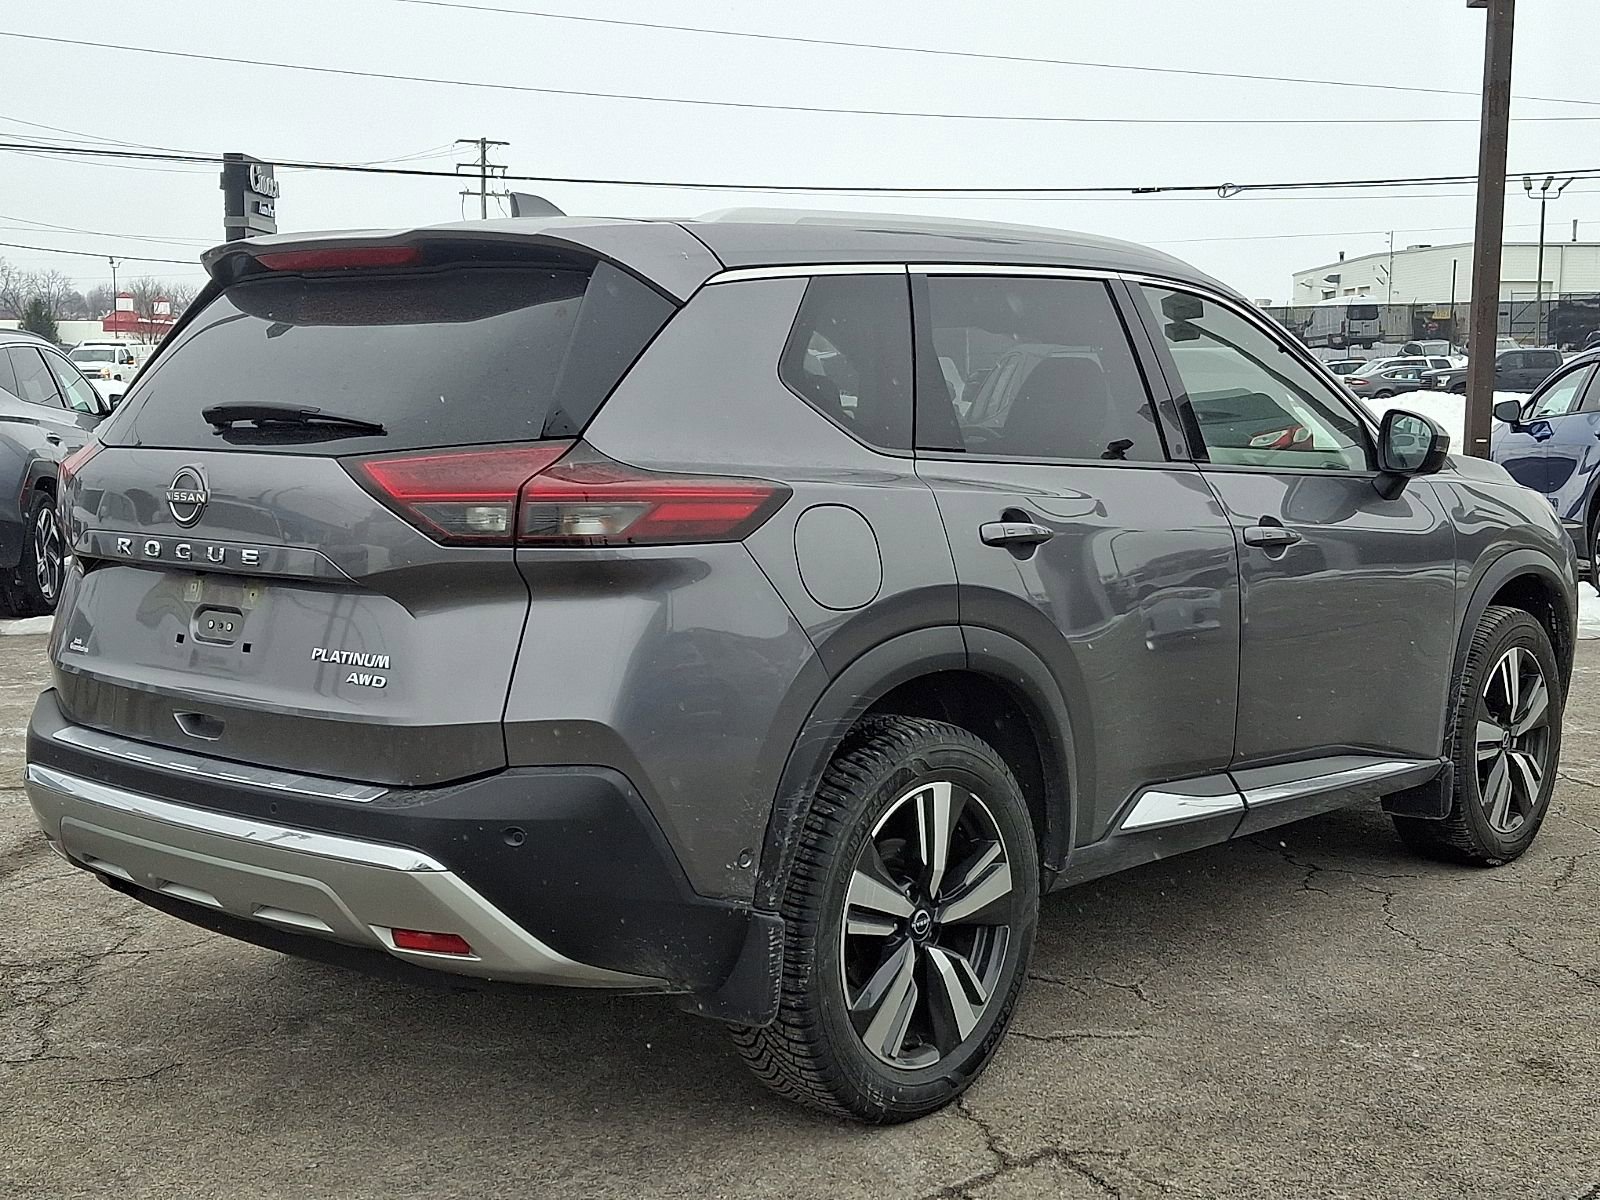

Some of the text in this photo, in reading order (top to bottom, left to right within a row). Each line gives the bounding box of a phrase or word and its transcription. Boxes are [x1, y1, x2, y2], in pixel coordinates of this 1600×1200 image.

[165, 491, 205, 502] NISSAN
[117, 537, 260, 565] ROGUE
[311, 647, 391, 669] PLATINUM
[345, 672, 387, 688] AWD
